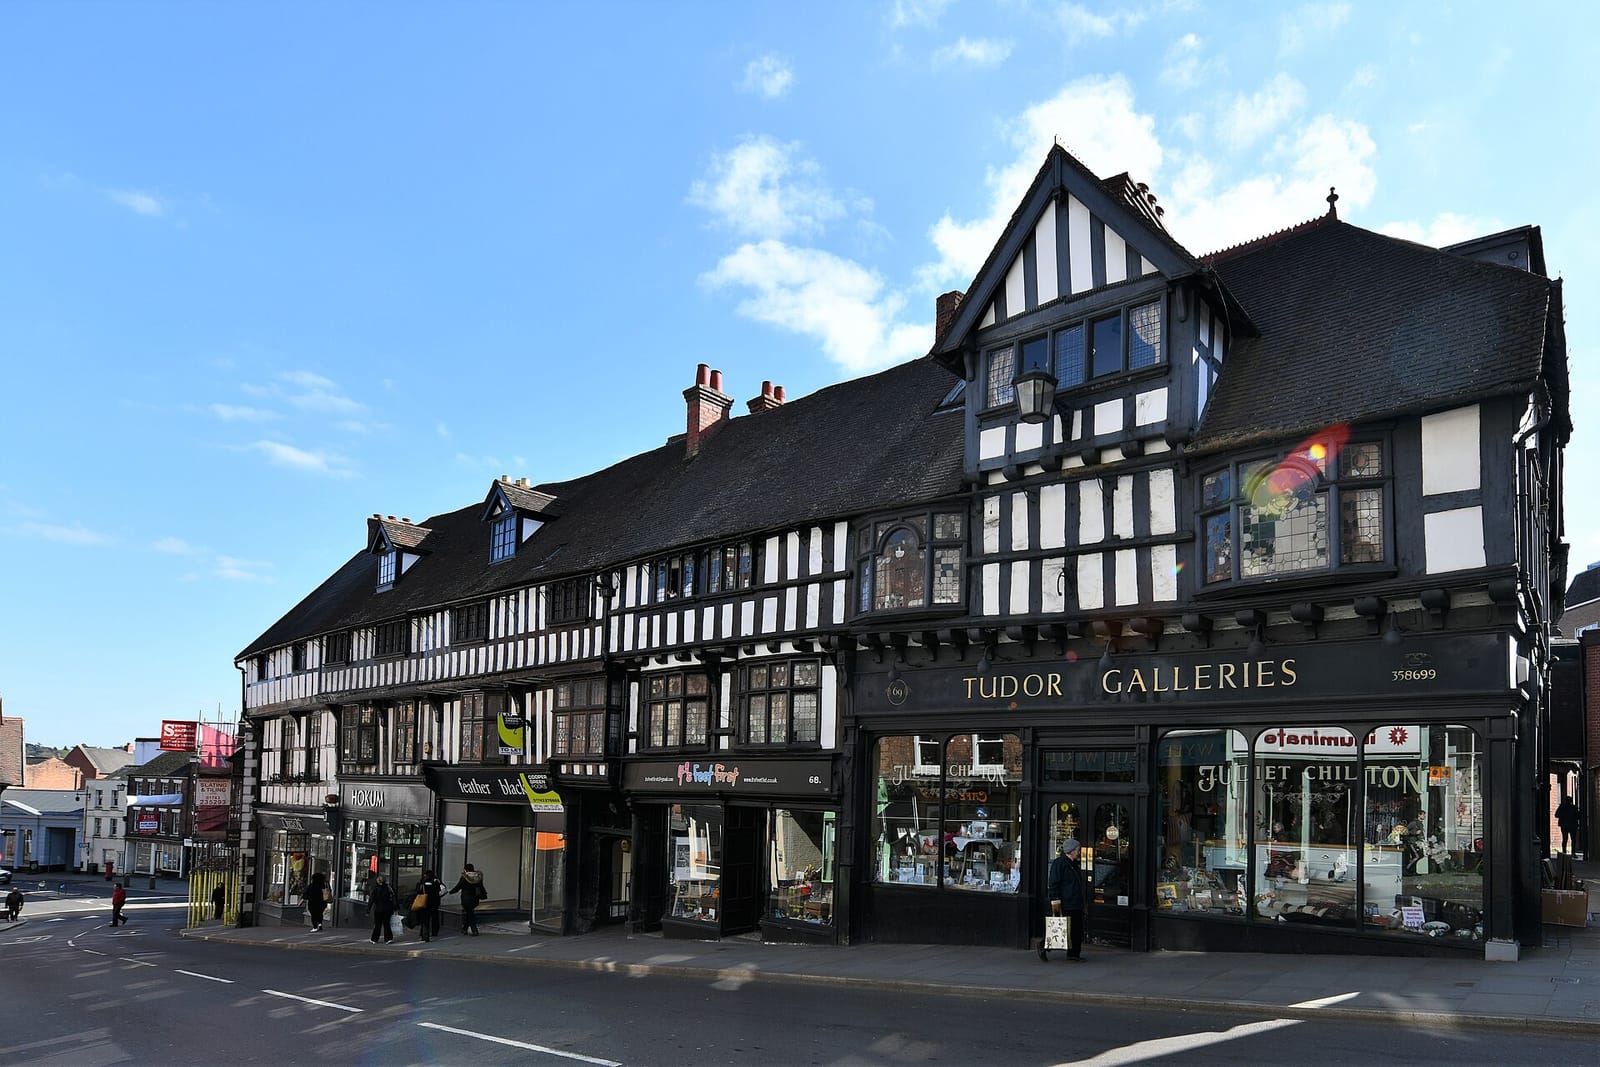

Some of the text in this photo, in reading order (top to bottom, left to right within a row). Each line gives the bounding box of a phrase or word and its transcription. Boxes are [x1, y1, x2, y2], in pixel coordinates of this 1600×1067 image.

[963, 657, 1298, 699] TUDOR GALLERIES
[1391, 669, 1437, 682] 358699
[892, 686, 903, 697] 69
[693, 763, 714, 786] Feet
[715, 764, 740, 787] First
[808, 775, 822, 784] 68.
[892, 764, 938, 786] JUL
[1198, 764, 1426, 796] JULIET CHILTON
[458, 777, 491, 795] feather
[351, 789, 385, 808] HOKUM
